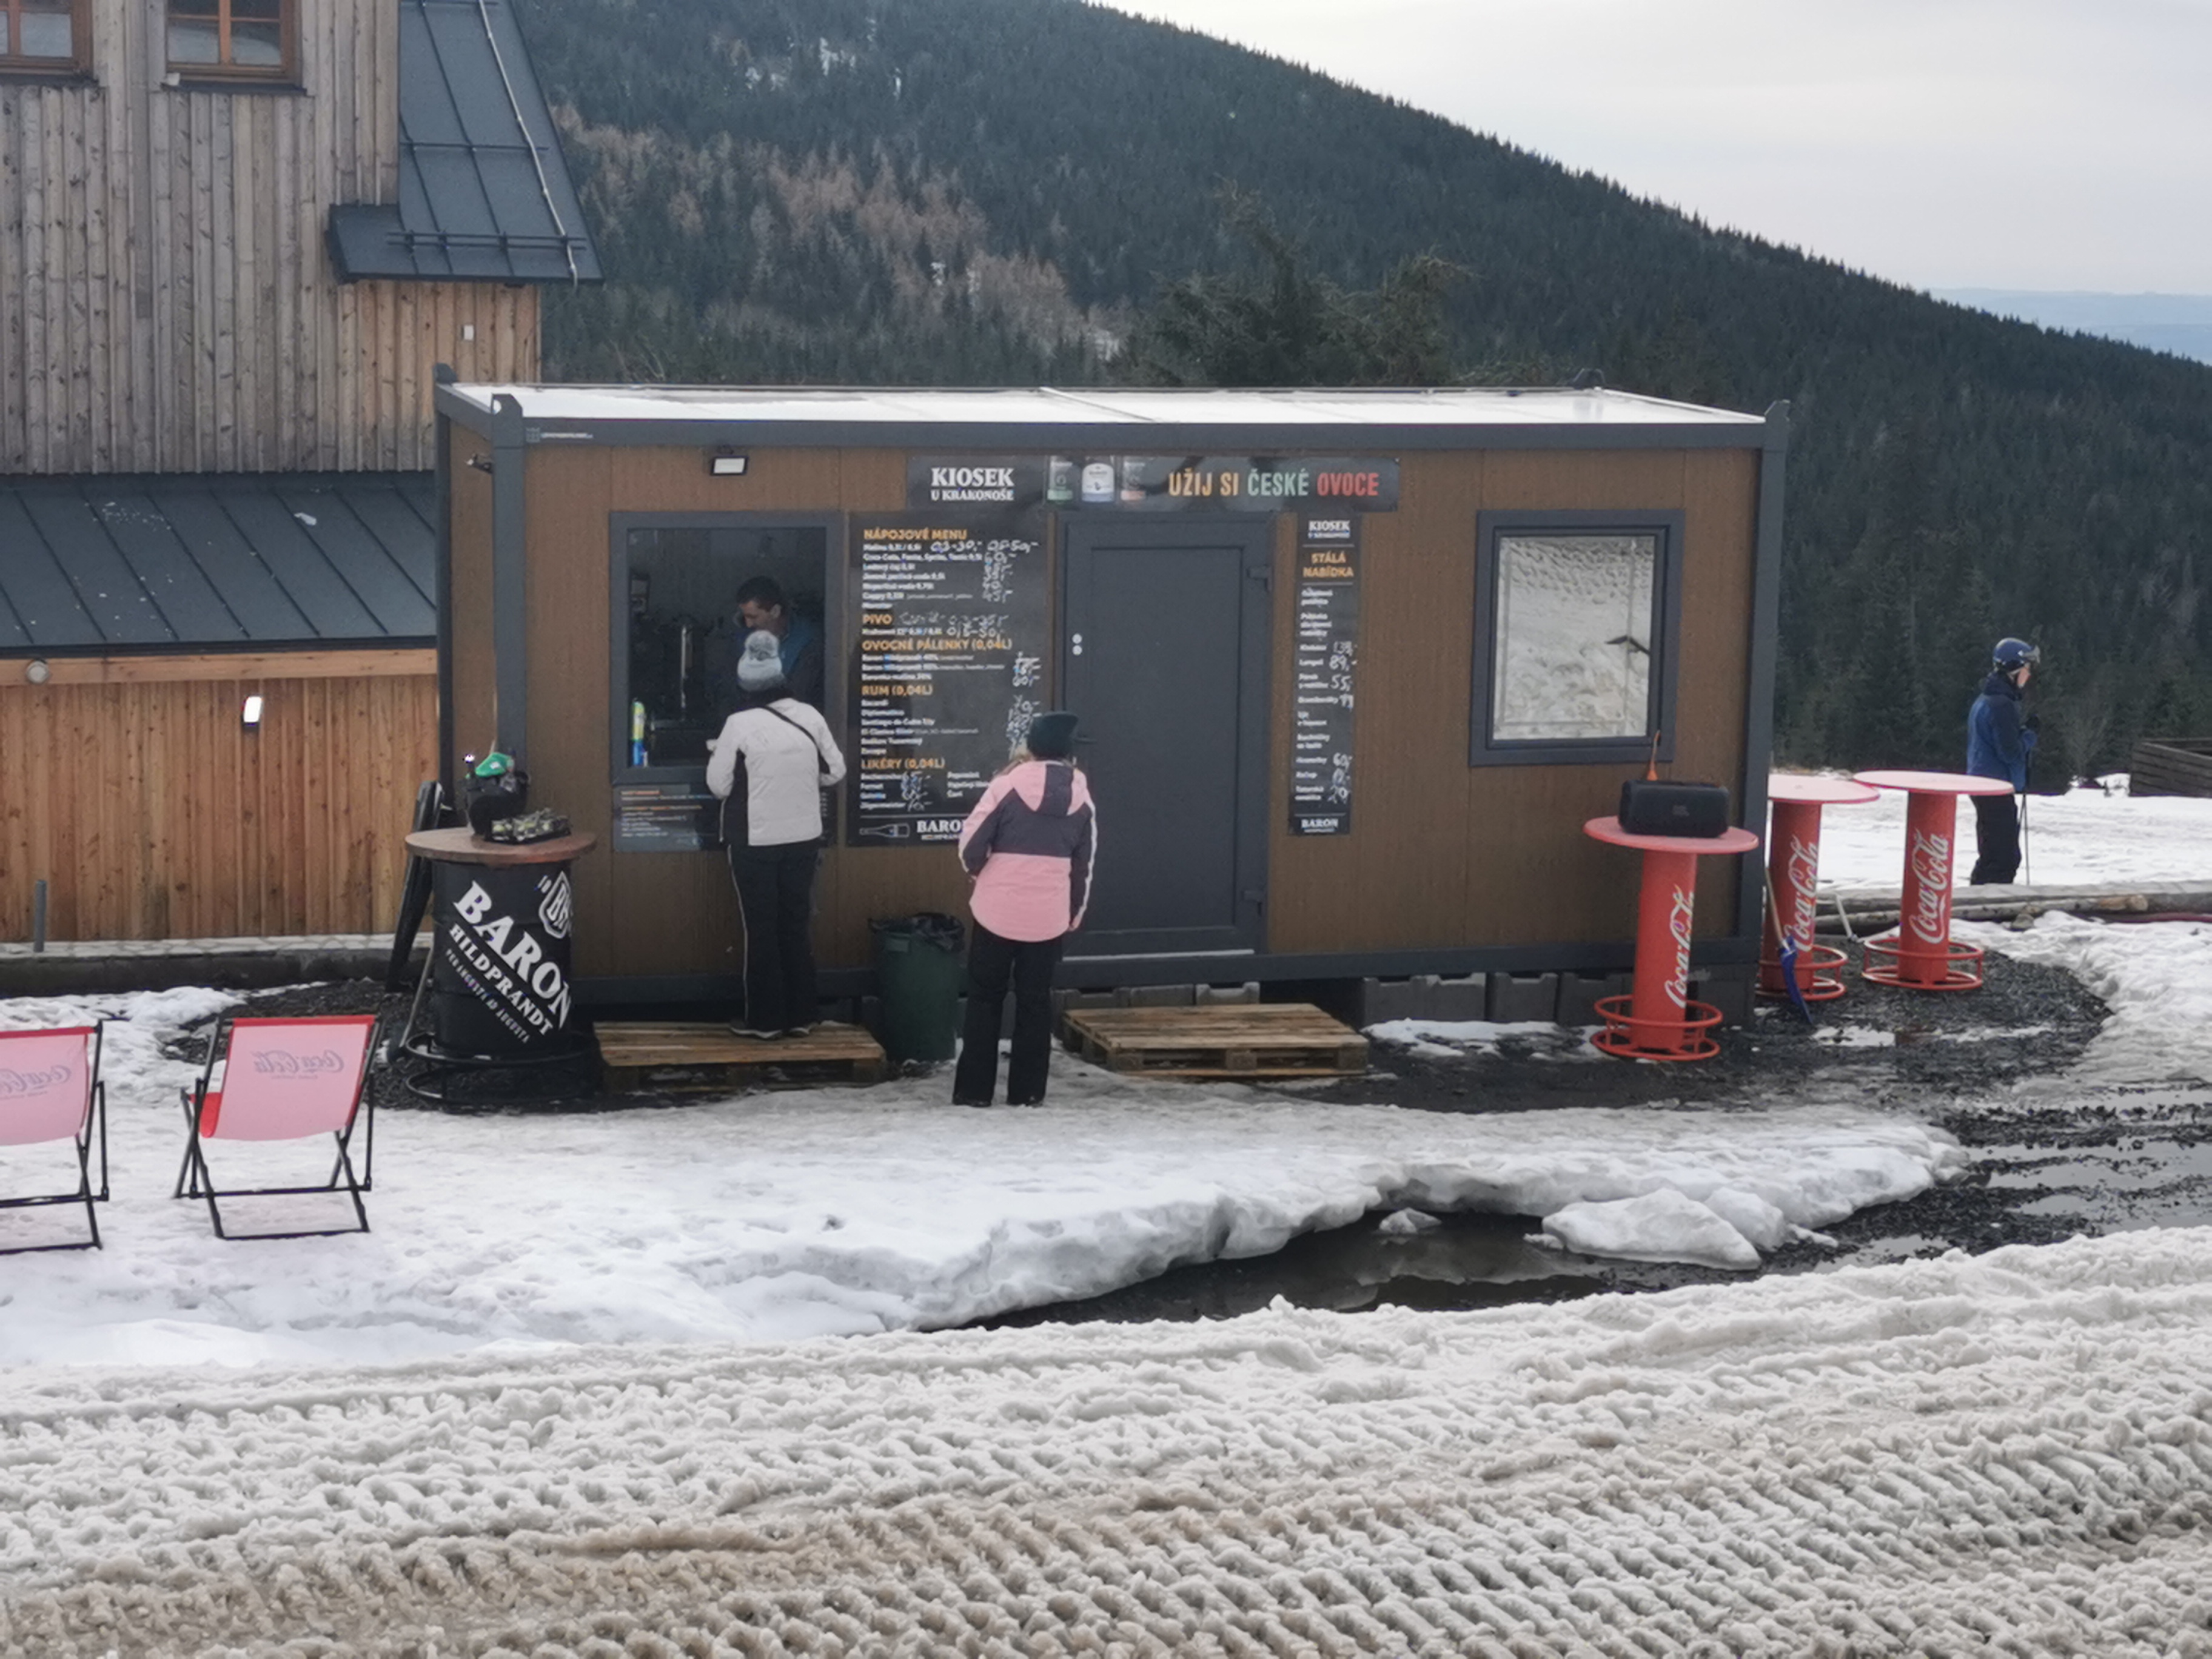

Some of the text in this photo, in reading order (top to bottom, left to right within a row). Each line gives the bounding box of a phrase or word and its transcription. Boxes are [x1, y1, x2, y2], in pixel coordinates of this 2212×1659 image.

[931, 468, 1014, 487] KIOSEK
[1169, 468, 1379, 496] UŽIJ SI ČESKÉ OVOCE
[931, 487, 1014, 501] U KRAKONOŠE
[1309, 520, 1350, 531] KIOSEK
[863, 527, 967, 540] NÁPOJOVÉ MENU
[1311, 551, 1346, 564] STÁLÁ
[1304, 565, 1354, 577] NABÍDKA
[862, 614, 893, 625] PIVO
[862, 638, 913, 651] OVOCNÉ
[917, 637, 968, 651] PÁLENKY
[862, 685, 889, 695] RUM
[862, 757, 902, 769] LIKÉRY
[1301, 819, 1338, 829] BARON
[1909, 826, 1949, 944] Coca-Cola
[453, 880, 571, 1030] BARON
[449, 923, 553, 1035] HILDPRANDT
